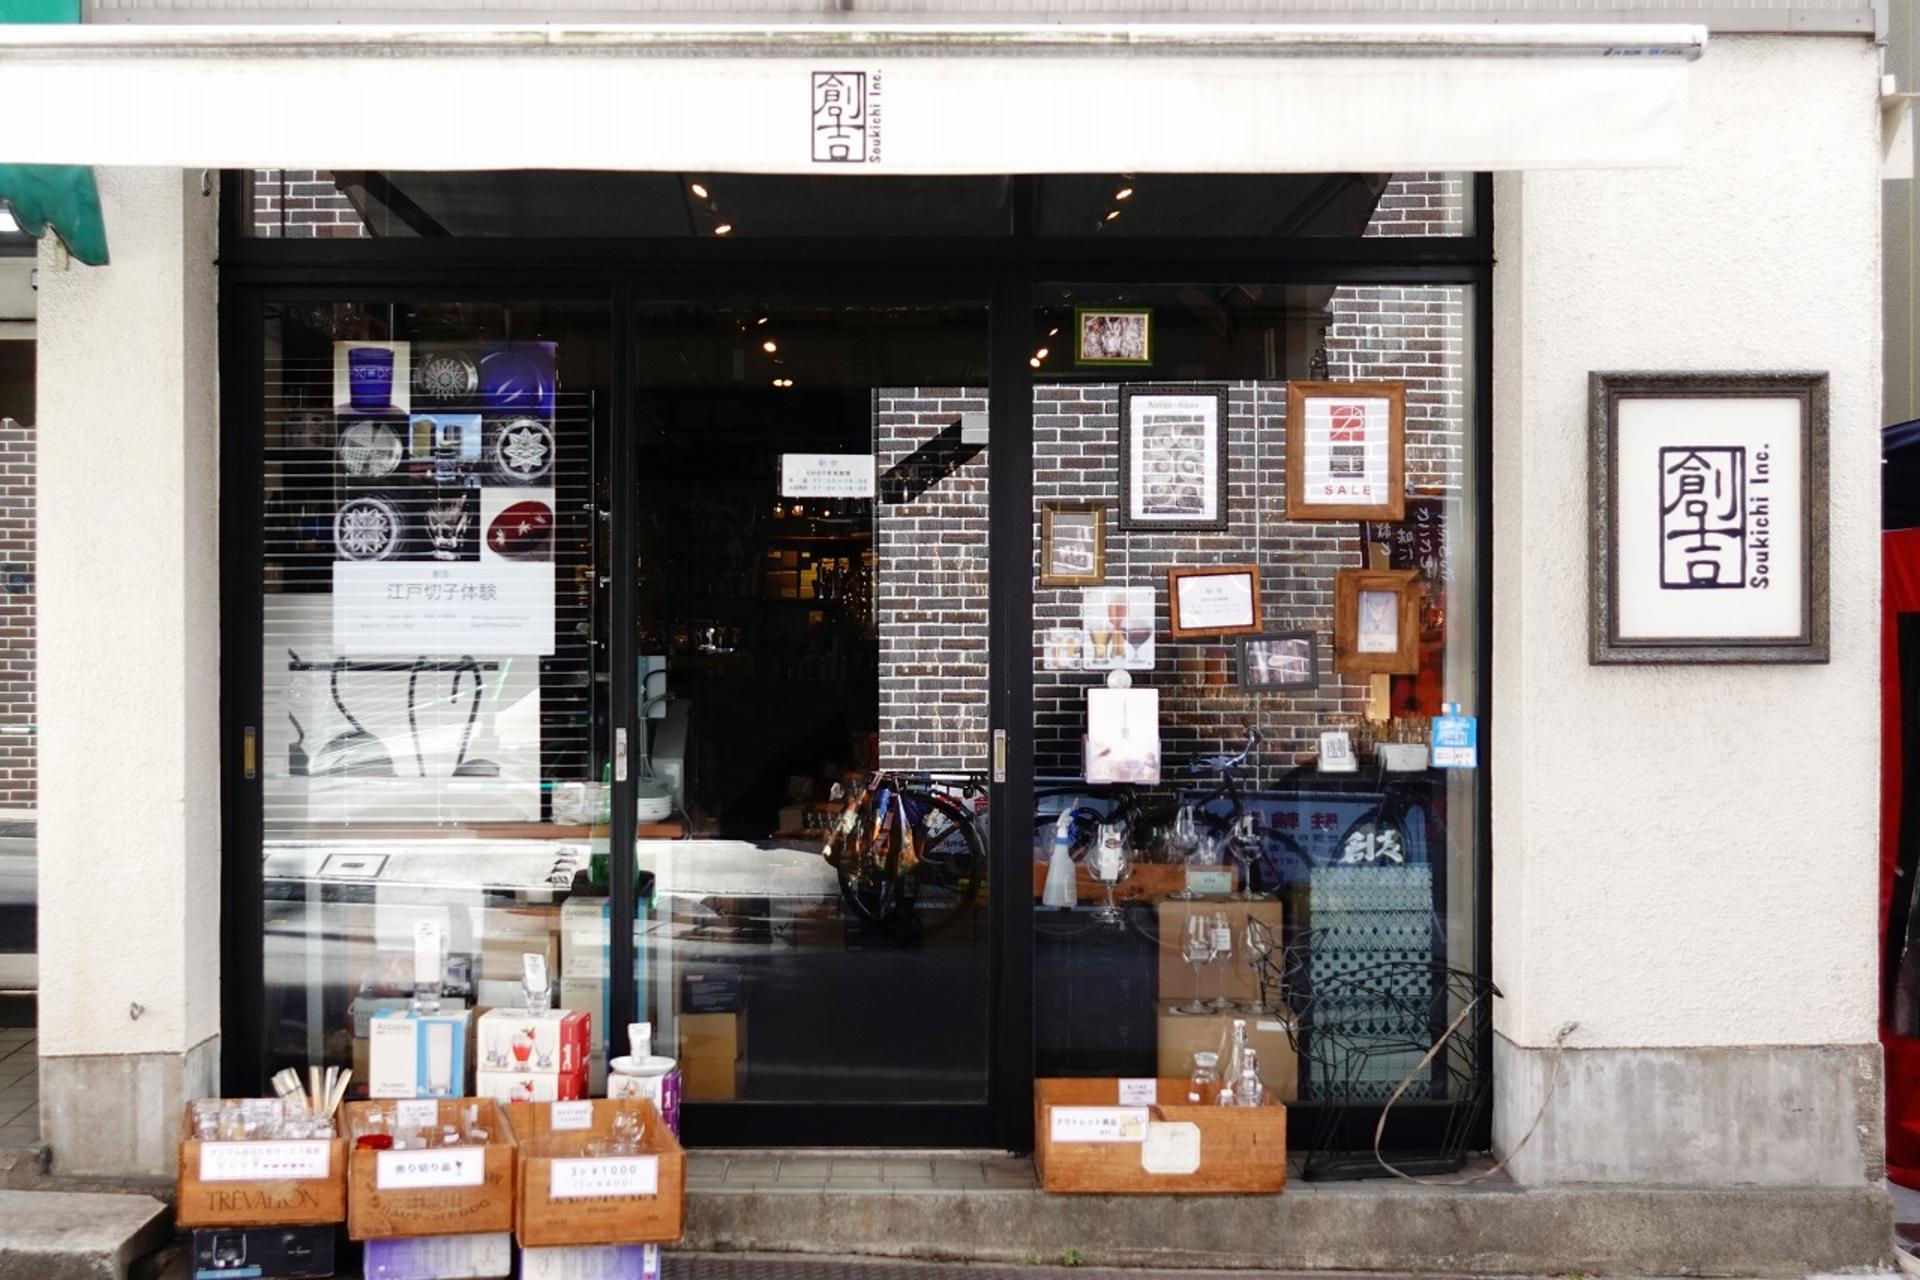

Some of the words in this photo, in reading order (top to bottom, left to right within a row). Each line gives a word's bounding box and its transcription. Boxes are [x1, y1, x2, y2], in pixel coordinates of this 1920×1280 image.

[869, 69, 882, 96] Inc.
[812, 71, 866, 162] 創吉
[869, 104, 881, 164] Soukichi
[1749, 443, 1769, 484] Inc.
[1324, 485, 1372, 496] SALE
[1659, 446, 1746, 589] 創吉
[1749, 496, 1769, 589] Soukichi
[386, 583, 497, 601] 江戸切子体験
